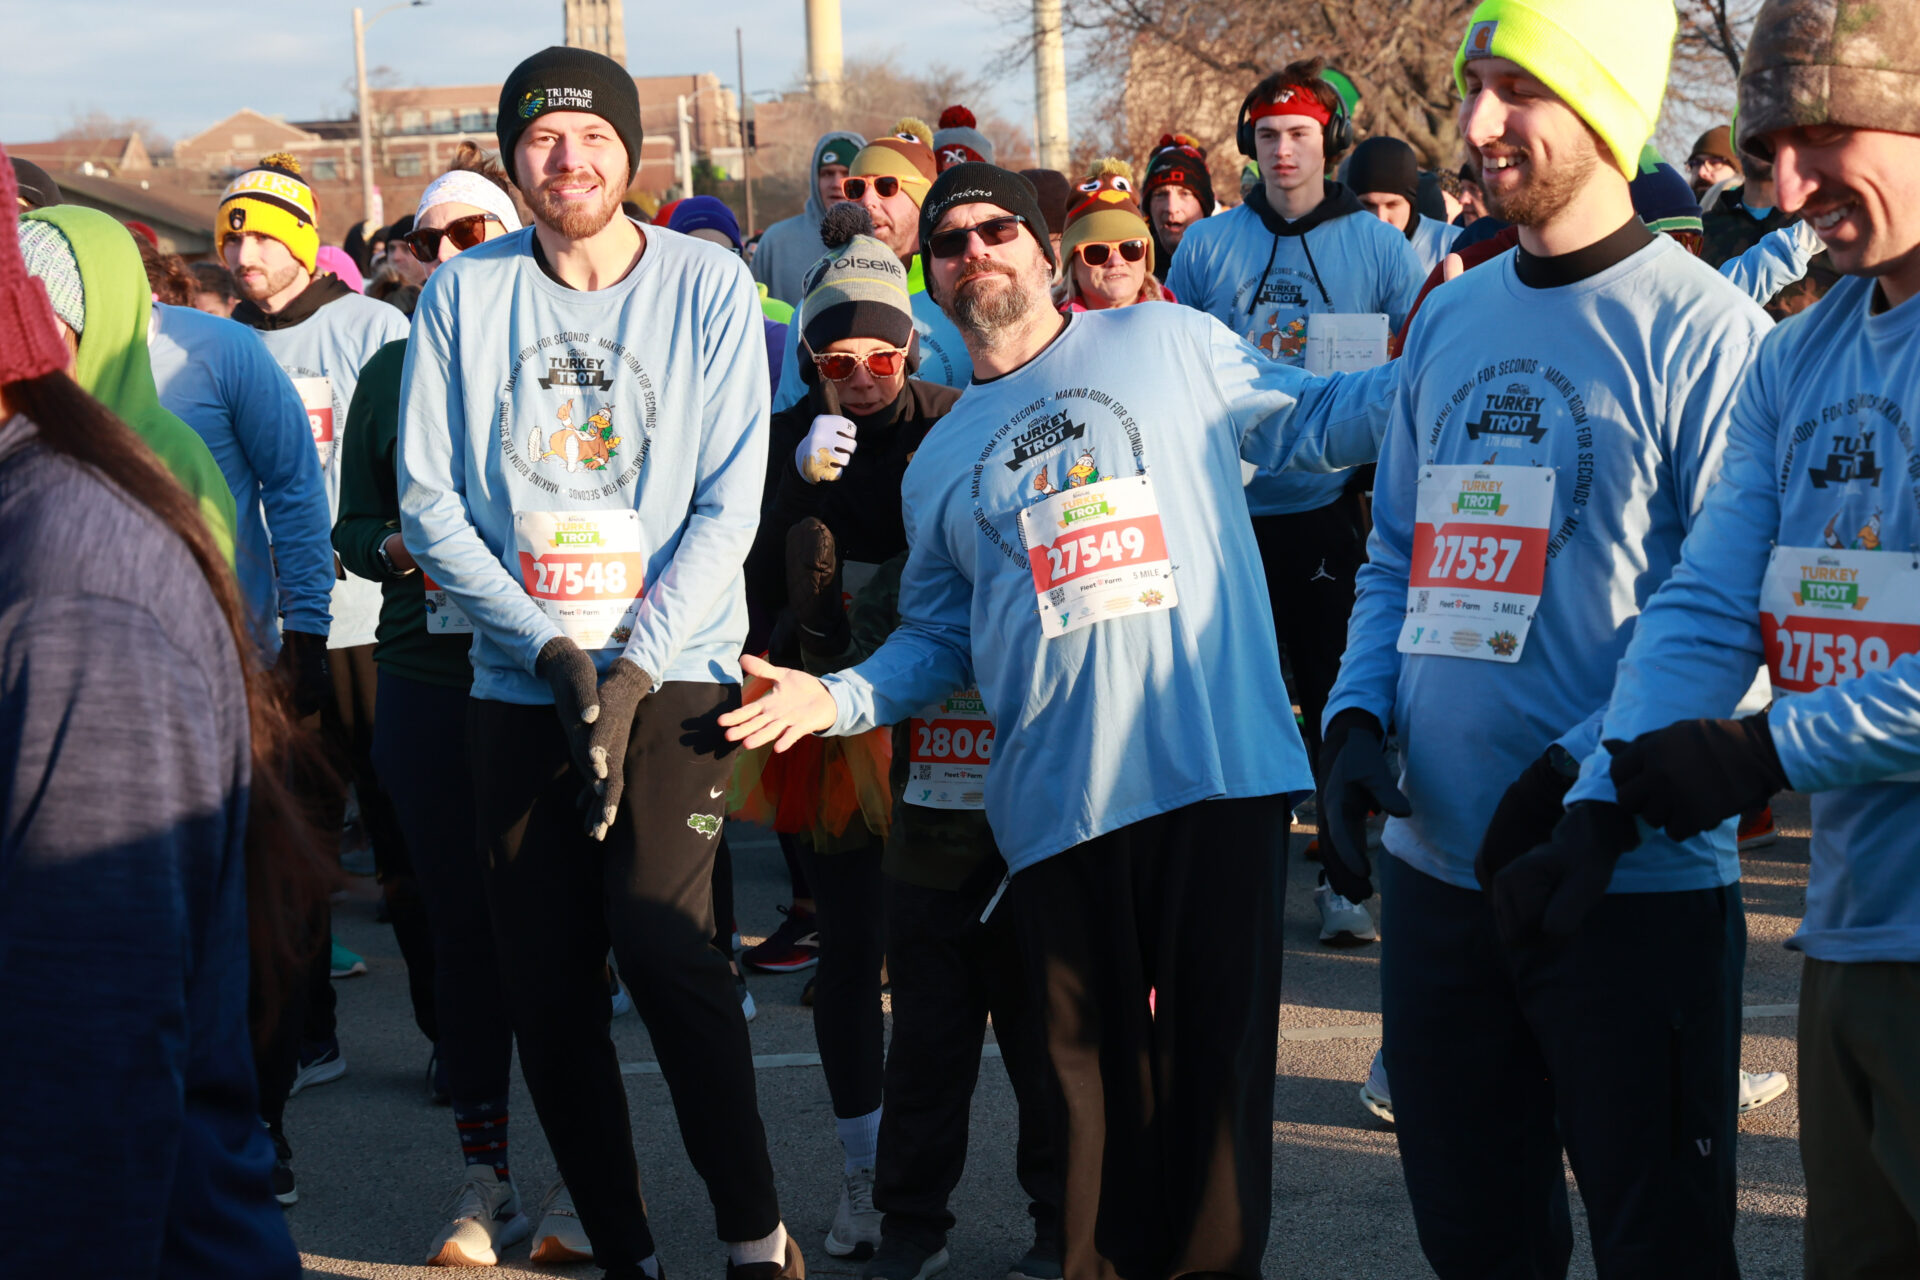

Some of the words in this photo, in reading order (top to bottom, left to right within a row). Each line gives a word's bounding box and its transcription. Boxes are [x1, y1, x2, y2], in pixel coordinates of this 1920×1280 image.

[546, 88, 562, 98] TRI
[564, 88, 593, 99] PHASE
[547, 98, 593, 109] ELECTRIC
[834, 255, 902, 279] oiselle
[1264, 284, 1303, 293] TURKEY
[1269, 293, 1297, 302] TROT
[536, 337, 552, 350] FOR
[553, 331, 590, 345] SECONDS
[597, 337, 627, 356] MAKING
[520, 345, 538, 363] ROOM
[549, 357, 605, 370] TURKEY
[622, 351, 644, 375] ROOM
[1477, 364, 1496, 385] FOR
[1498, 357, 1539, 377] SECONDS
[504, 363, 522, 393] MAKING
[556, 371, 597, 385] TROT
[637, 371, 652, 391] FOR
[1543, 365, 1576, 399] MAKING
[1055, 387, 1089, 401] MAKING
[1087, 389, 1114, 407] ROOM
[1451, 377, 1476, 407] ROOM
[643, 391, 657, 429] SECONDS
[1010, 397, 1046, 427] SECONDS
[1109, 401, 1128, 420] FOR
[1486, 394, 1546, 412] TURKEY
[1567, 393, 1590, 427] ROOM
[498, 401, 511, 440] SECONDS
[1011, 408, 1068, 448] TURKEY
[1429, 402, 1454, 446] MAKING
[1487, 414, 1532, 433] TROT
[994, 423, 1012, 440] FOR
[1022, 425, 1065, 457] TROT
[1121, 416, 1145, 458] SECONDS
[1575, 426, 1593, 450] FOR
[500, 440, 515, 455] FOR
[632, 437, 652, 469] MAKING
[979, 439, 998, 463] ROOM
[508, 451, 532, 477] ROOM
[528, 471, 560, 495] MAKING
[615, 467, 637, 488] ROOM
[971, 464, 984, 499] MAKING
[1461, 480, 1503, 492] TURKEY
[1572, 452, 1595, 507] SECONDS
[568, 487, 601, 501] SECONDS
[601, 482, 618, 497] FOR
[1061, 492, 1105, 510] TURKEY
[1463, 494, 1495, 508] TROT
[1069, 503, 1102, 520] TROT
[973, 506, 1002, 545] SECONDS
[561, 532, 594, 543] TROT
[1546, 515, 1580, 559] MAKING
[1046, 526, 1145, 581] 27549
[1428, 535, 1523, 583] 27537
[533, 561, 628, 595] 27548
[1132, 571, 1139, 580] 5
[1140, 569, 1160, 579] MILE
[1801, 566, 1859, 582] TURKEY
[1080, 582, 1097, 592] Fleet
[1104, 577, 1123, 585] Farm
[1807, 583, 1850, 600] TROT
[1440, 600, 1455, 609] Fleet
[1461, 602, 1481, 611] Farm
[1493, 602, 1499, 613] 5
[1501, 602, 1526, 615] MILE
[951, 701, 982, 709] TROT
